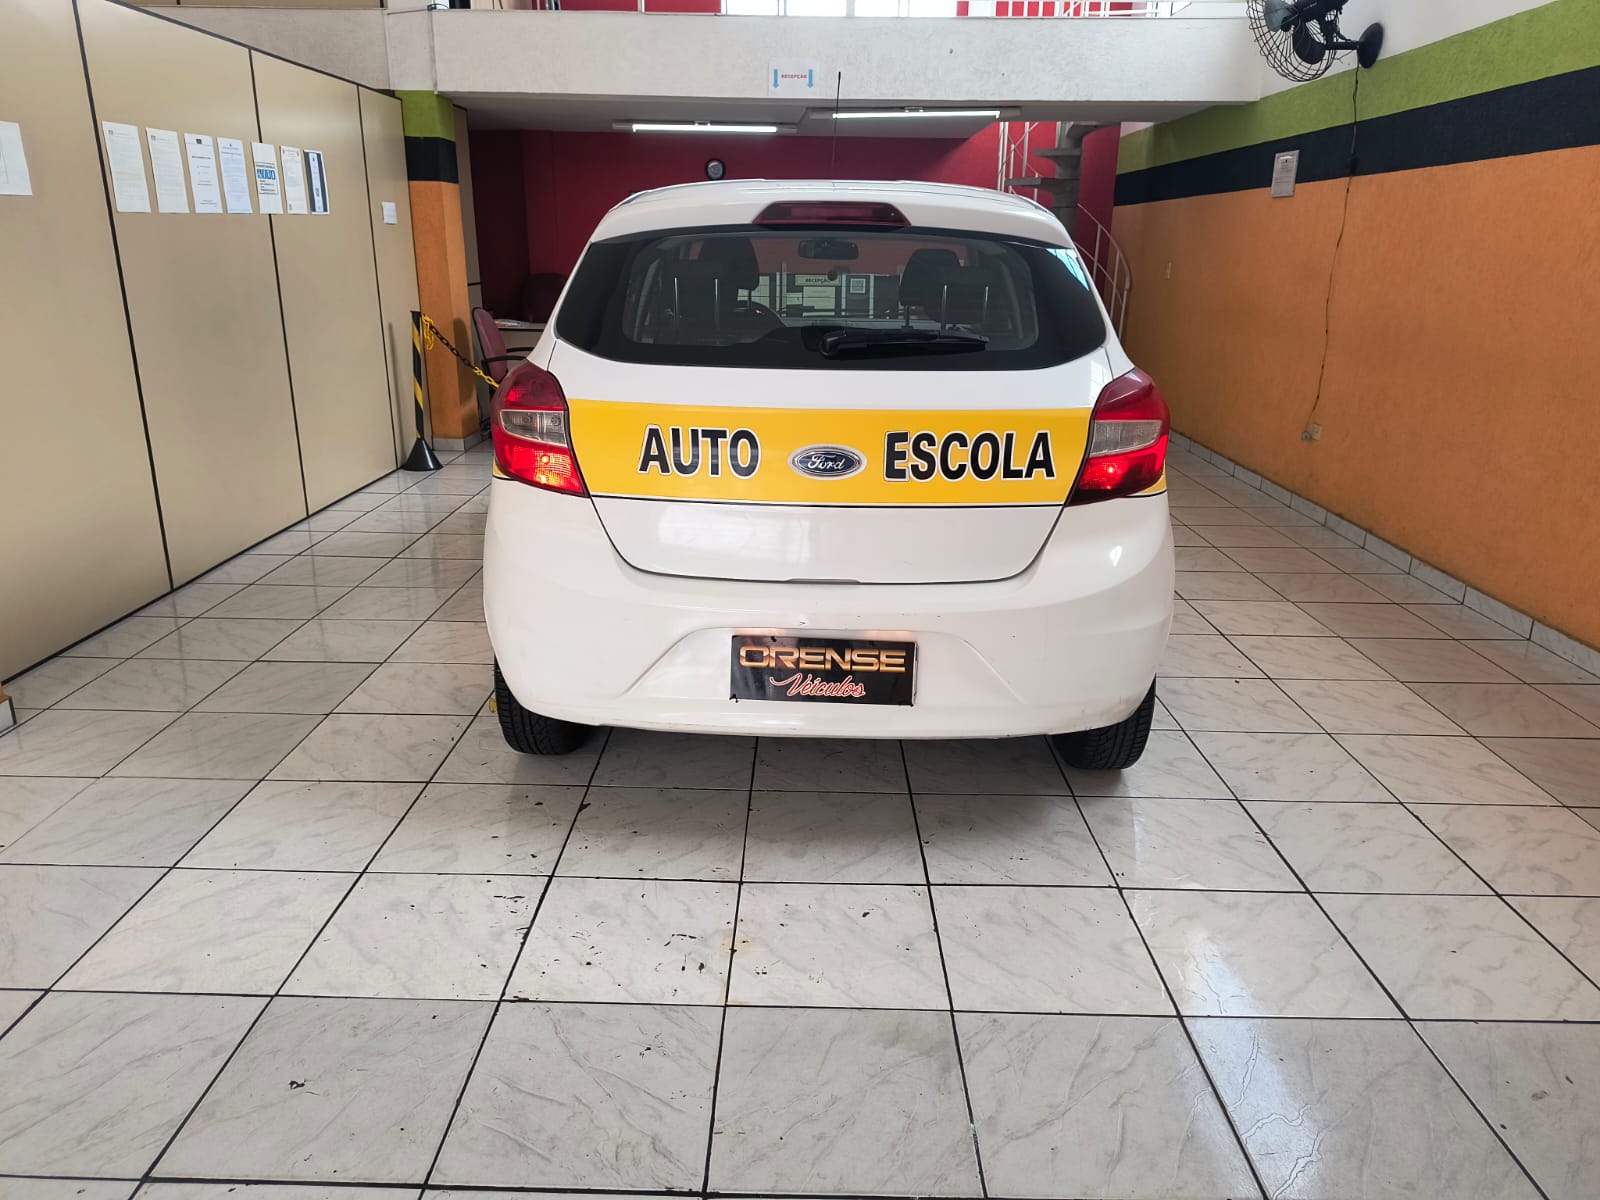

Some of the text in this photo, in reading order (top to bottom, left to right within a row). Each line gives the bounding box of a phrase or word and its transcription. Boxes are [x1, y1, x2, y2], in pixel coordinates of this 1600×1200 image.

[638, 425, 1056, 482] AUTO ESCOLA
[807, 453, 845, 470] Ford
[739, 646, 906, 673] ORENSE
